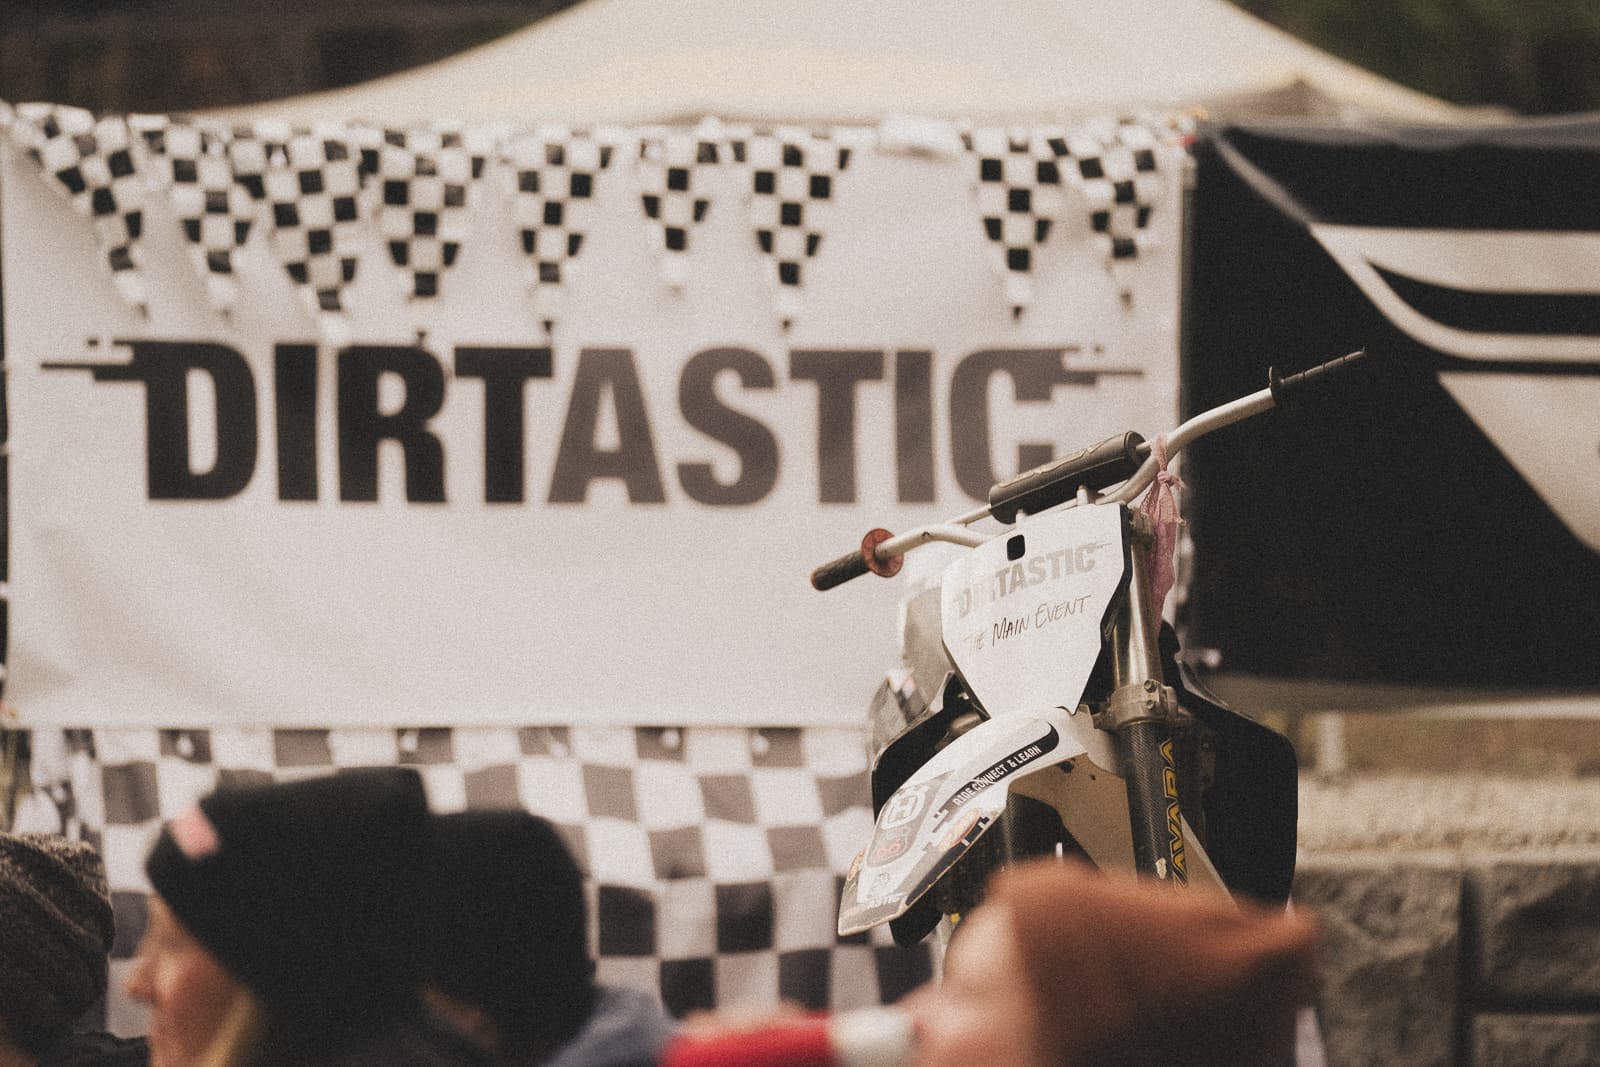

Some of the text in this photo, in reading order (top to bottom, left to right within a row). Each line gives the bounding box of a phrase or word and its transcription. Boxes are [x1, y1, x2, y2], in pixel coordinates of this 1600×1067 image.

[90, 340, 1100, 506] DIRTASTIC
[953, 542, 1104, 618] DTASTIC
[992, 614, 1030, 647] MAIN
[1034, 594, 1092, 629] EVENT
[953, 745, 1043, 806] RIDE CONNECT & LEARN
